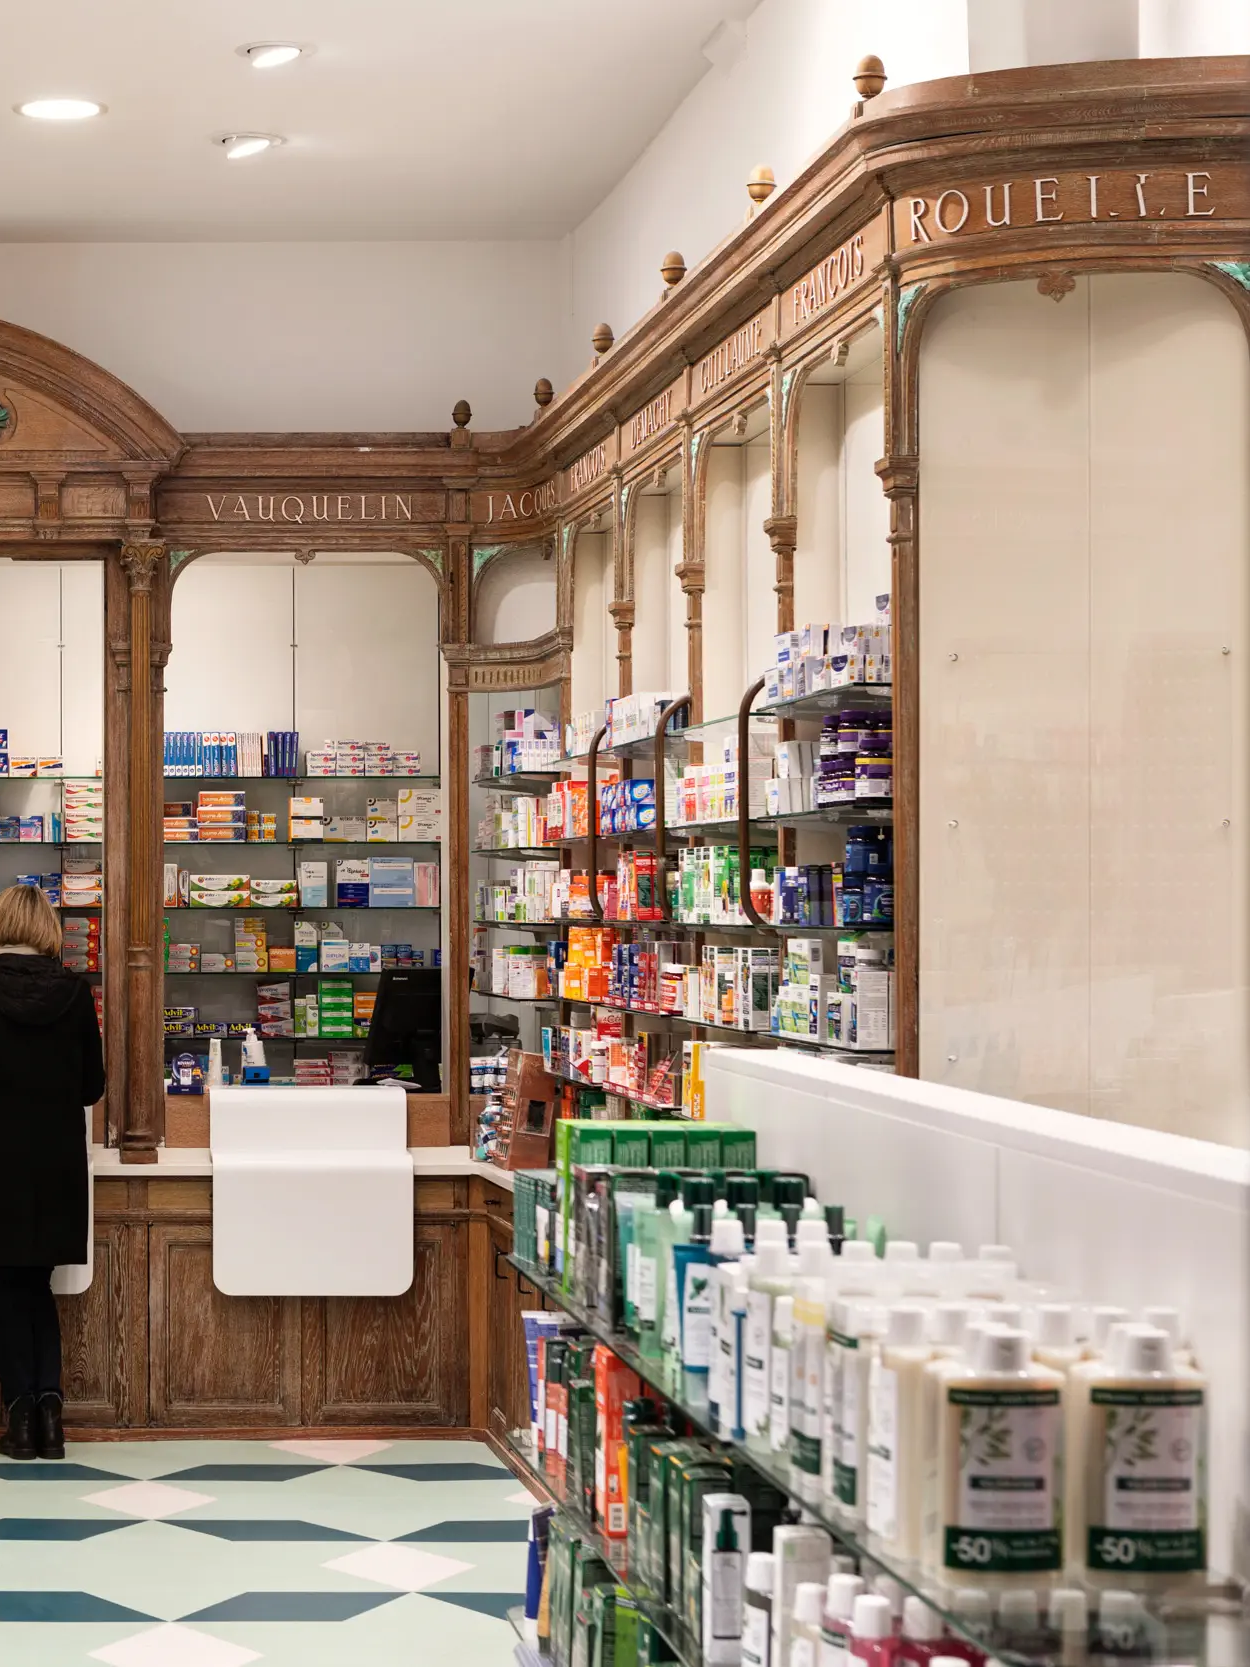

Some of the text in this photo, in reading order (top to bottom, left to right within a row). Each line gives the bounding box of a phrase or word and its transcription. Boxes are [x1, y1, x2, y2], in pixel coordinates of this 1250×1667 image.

[700, 318, 763, 394] GUILLAUME
[630, 389, 673, 449] DEMACHY
[204, 494, 415, 524] VAUQUELIN
[485, 480, 556, 524] JACQUES
